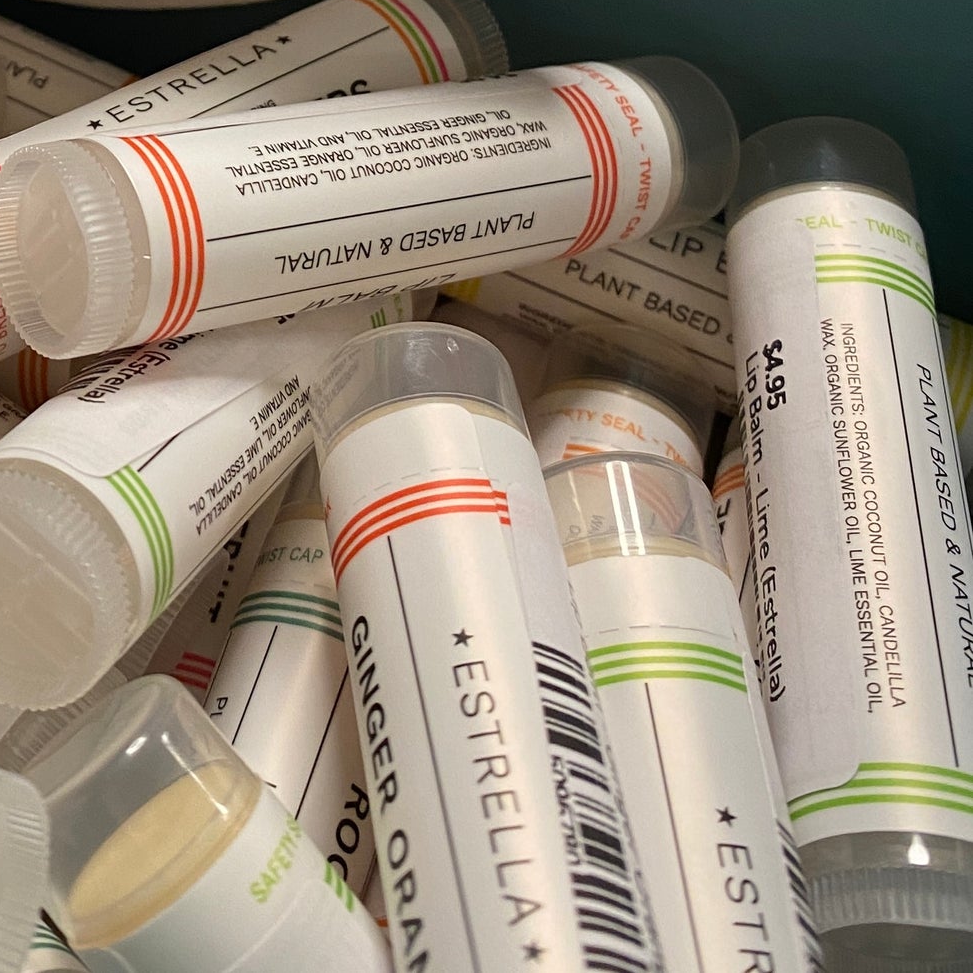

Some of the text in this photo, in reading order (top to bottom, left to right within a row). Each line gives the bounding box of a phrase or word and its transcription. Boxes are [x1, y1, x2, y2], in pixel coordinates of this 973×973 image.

[105, 41, 277, 124] ESTRELLA
[225, 120, 548, 178] WAX, ORGANIC SUNFLOWER OIL, ORANGE ESSENTIAL
[248, 109, 511, 157] OIL, GINGER ESSENTIAL OIL, AND VITAMIN E.
[615, 96, 643, 137] SEAL
[636, 157, 651, 211] TWIST
[235, 137, 552, 196] INGREDIENTS: ORGANIC COCONUT OIL, CANDELILLA
[275, 211, 536, 274] PLANT BASED & NATURAL
[796, 215, 844, 230] EAL
[865, 218, 912, 248] TWIST
[565, 258, 721, 335] PLANT BASED
[76, 348, 173, 404] (Estrella)
[285, 374, 301, 398] AND
[745, 351, 758, 395] Lip
[762, 339, 787, 411] $4.95
[258, 390, 287, 425] VITAMIN
[601, 413, 647, 442] SEAL
[749, 396, 764, 466] Balm
[245, 437, 264, 459] LIME
[259, 431, 292, 474] COCONUT
[205, 454, 246, 503] ESSENTIAL
[196, 481, 243, 536] CANDELILLA
[756, 488, 770, 560] Lime
[820, 318, 883, 714] WAX, ORGANIC SUNFLOWER OIL, LIME ESSENTIAL OIL,
[841, 322, 907, 708] INGREDIENTS: ORGANIC COCONUT OIL, CANDELILLA
[917, 363, 973, 688] PLANT BASED & NATURAL
[289, 547, 324, 564] CAP
[759, 566, 786, 703] (Estrella)
[351, 615, 398, 815] GINGER
[452, 659, 543, 926] ESTRELLA
